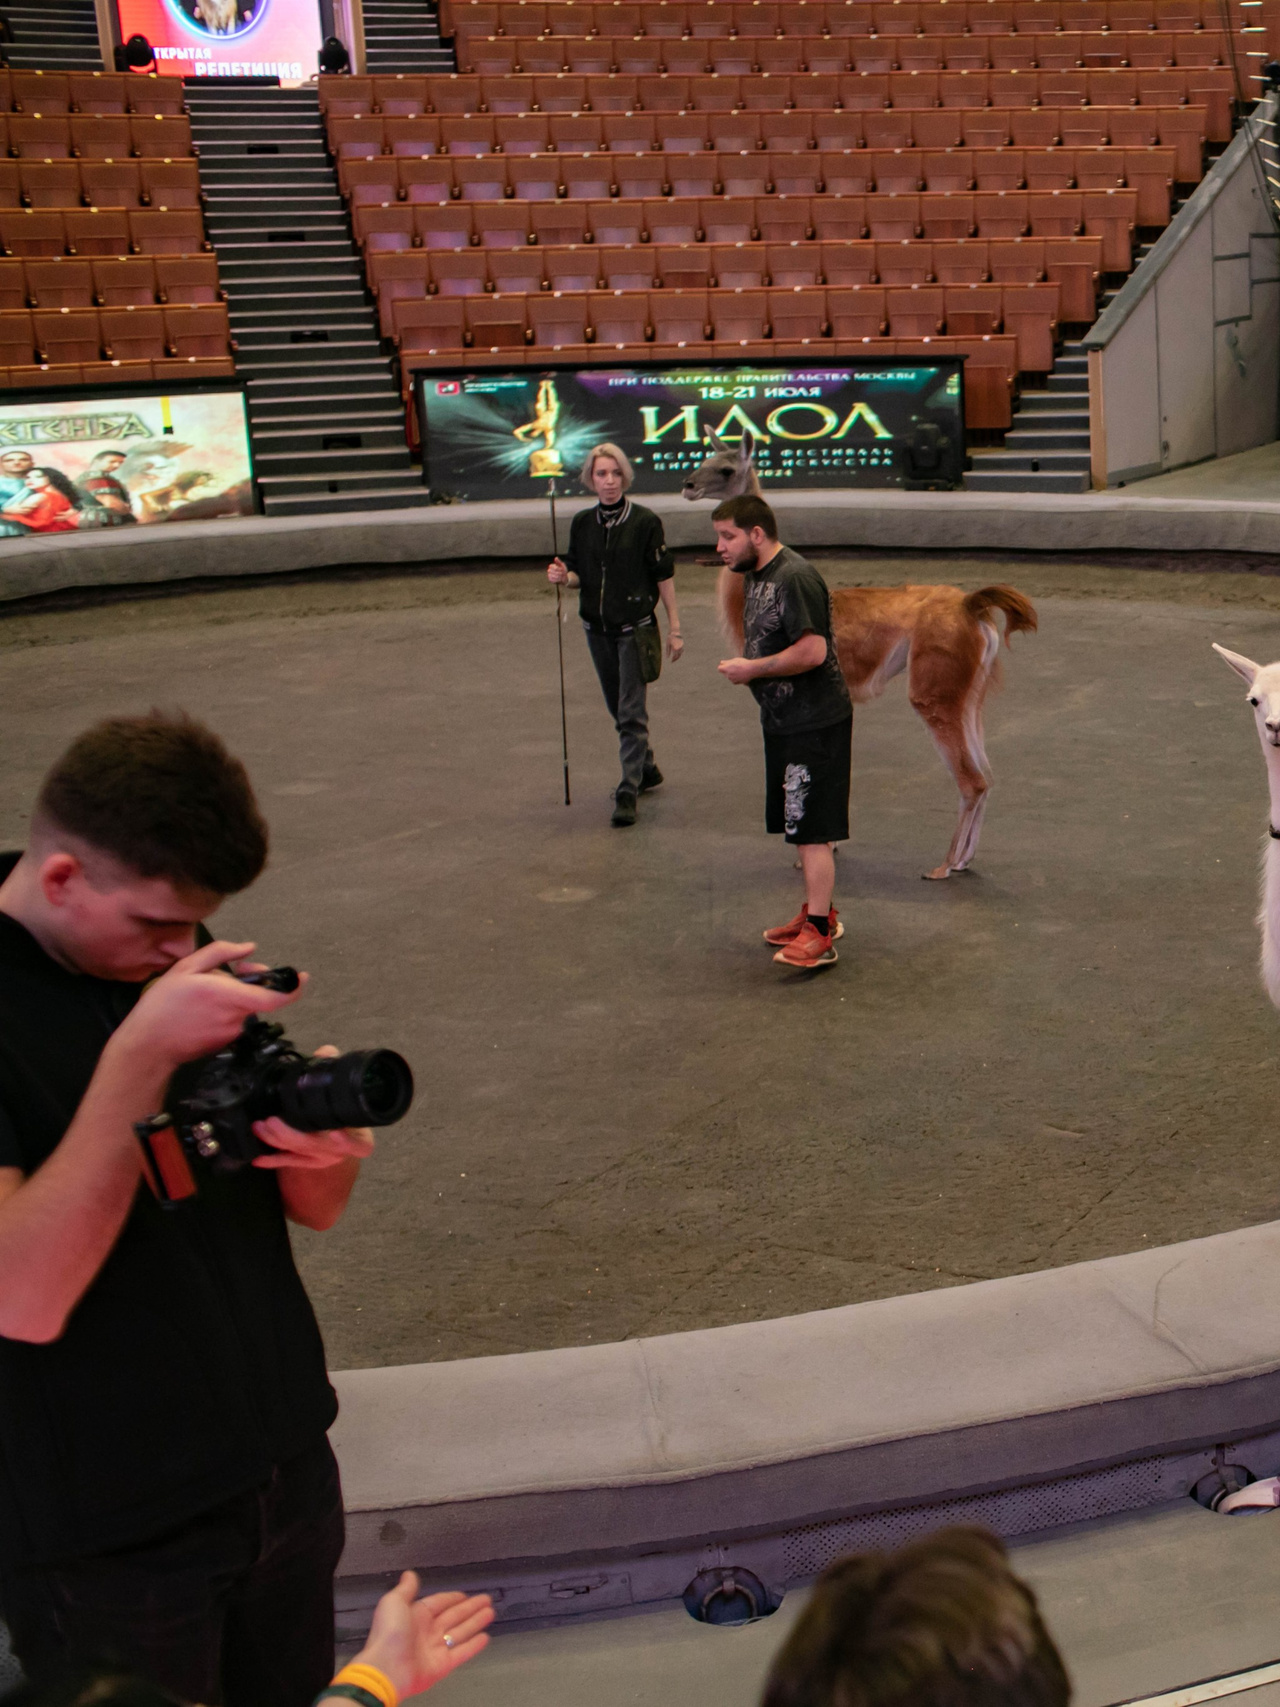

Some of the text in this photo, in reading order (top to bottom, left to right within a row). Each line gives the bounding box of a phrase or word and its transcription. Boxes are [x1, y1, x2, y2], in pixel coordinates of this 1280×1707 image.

[153, 47, 212, 59] ТКРЫТАЯ
[195, 62, 302, 78] РЕПЕТИЦИЯ
[608, 371, 917, 386] ПРИ ПОДДЕРЖКЕ ПРАВИТЕЛЬСТВА МОСКВЫ
[698, 385, 822, 400] 18-21 ИЮЛЯ
[0, 414, 153, 447] ЕГЕНДА
[639, 402, 894, 445] ИДОЛ
[780, 448, 893, 458] ФЕСТИВАЛЬ
[782, 457, 892, 468] ИСКУССТВА
